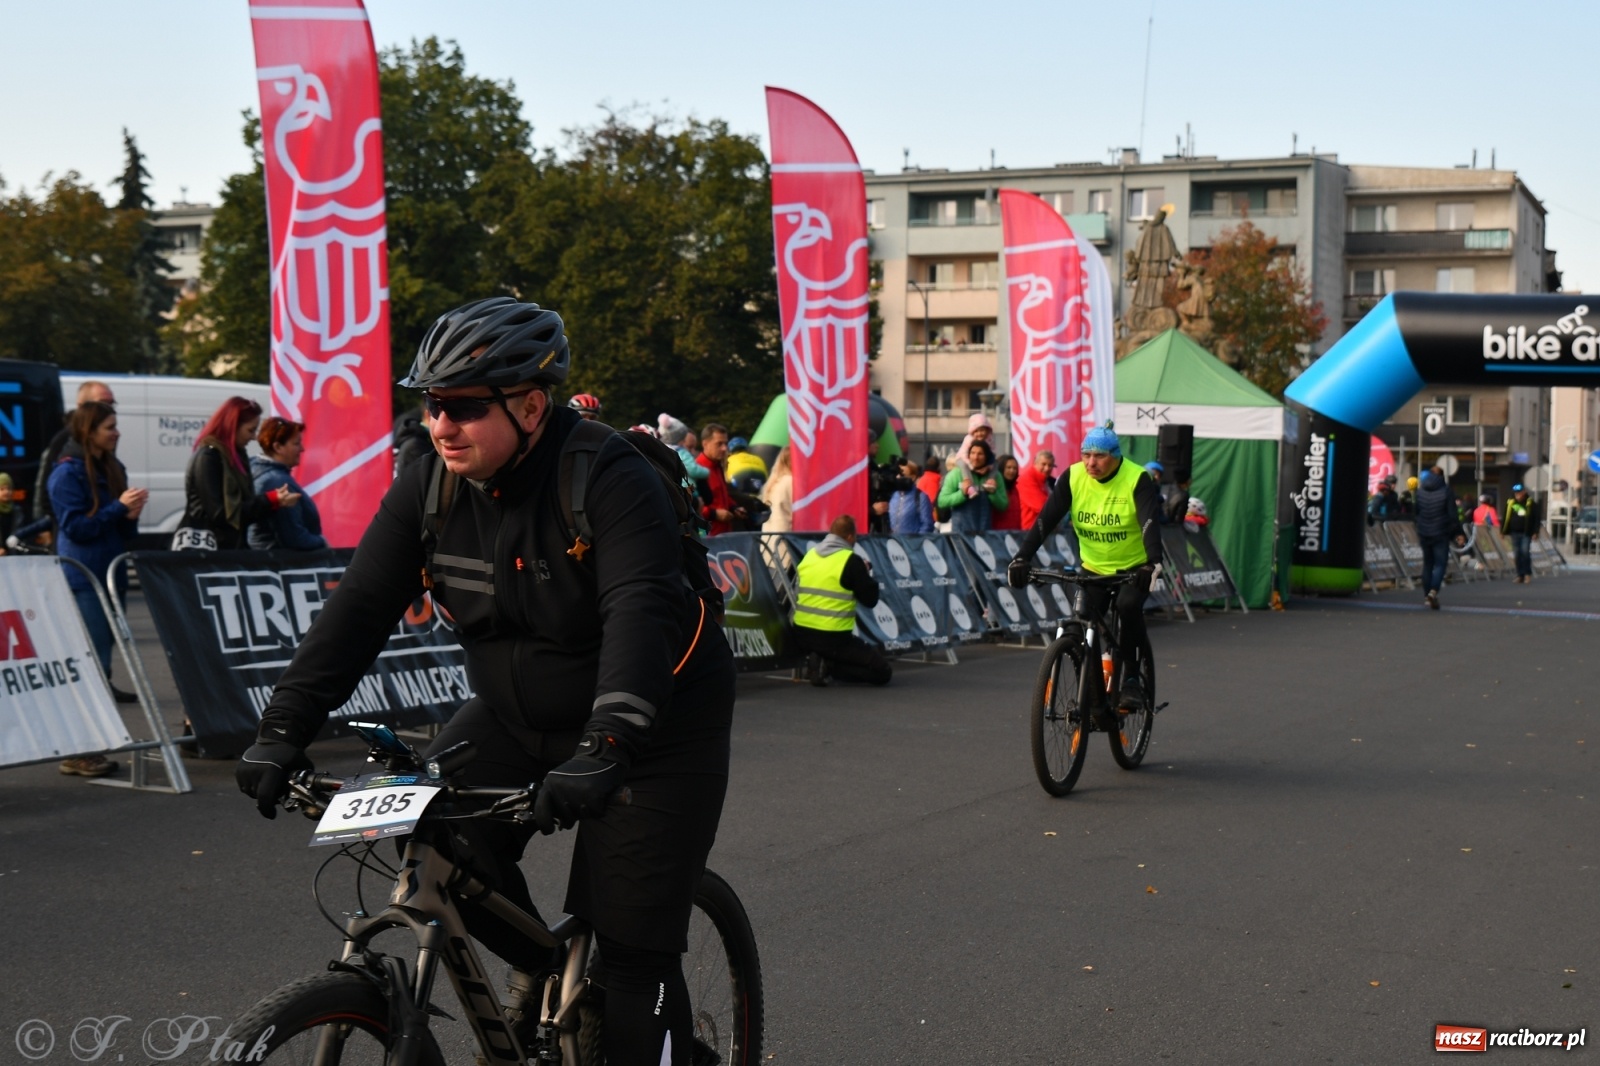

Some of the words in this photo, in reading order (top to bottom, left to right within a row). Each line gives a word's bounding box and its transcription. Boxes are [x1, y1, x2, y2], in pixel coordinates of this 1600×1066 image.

[1483, 325, 1562, 361] bike
[1425, 413, 1441, 436] 0
[1304, 433, 1327, 501] atelier
[1078, 510, 1121, 526] OBSŁUGA
[1299, 506, 1321, 551] bike
[0, 657, 81, 696] RIENDS
[342, 792, 416, 819] 3185
